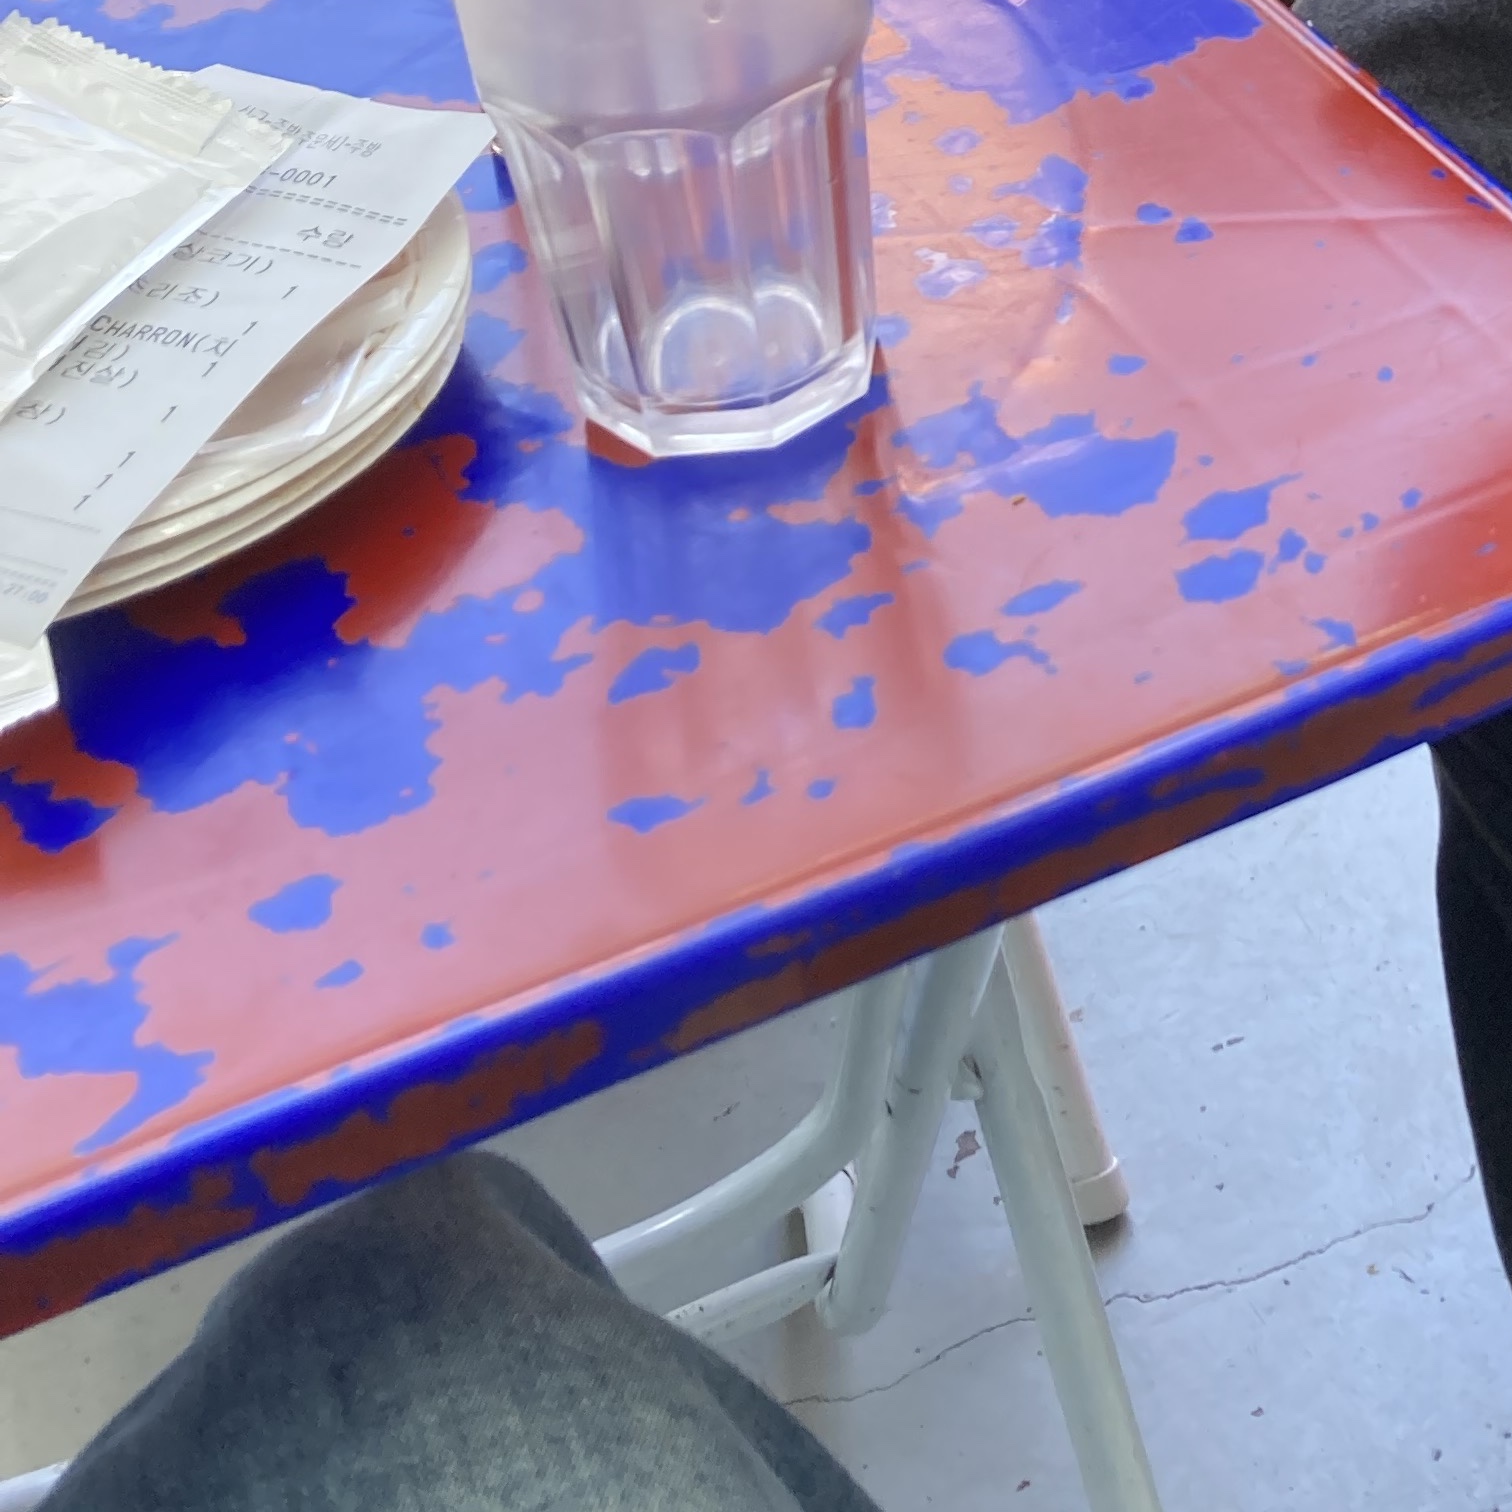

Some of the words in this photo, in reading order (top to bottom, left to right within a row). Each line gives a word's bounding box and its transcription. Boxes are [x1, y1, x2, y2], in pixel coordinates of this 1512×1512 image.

[297, 225, 354, 249] 수량
[281, 284, 299, 300] 1
[241, 320, 259, 336] 1
[201, 360, 218, 378] 1
[160, 404, 179, 423] 1
[117, 450, 137, 469] 1
[95, 473, 114, 490] 1
[73, 494, 92, 512] 1
